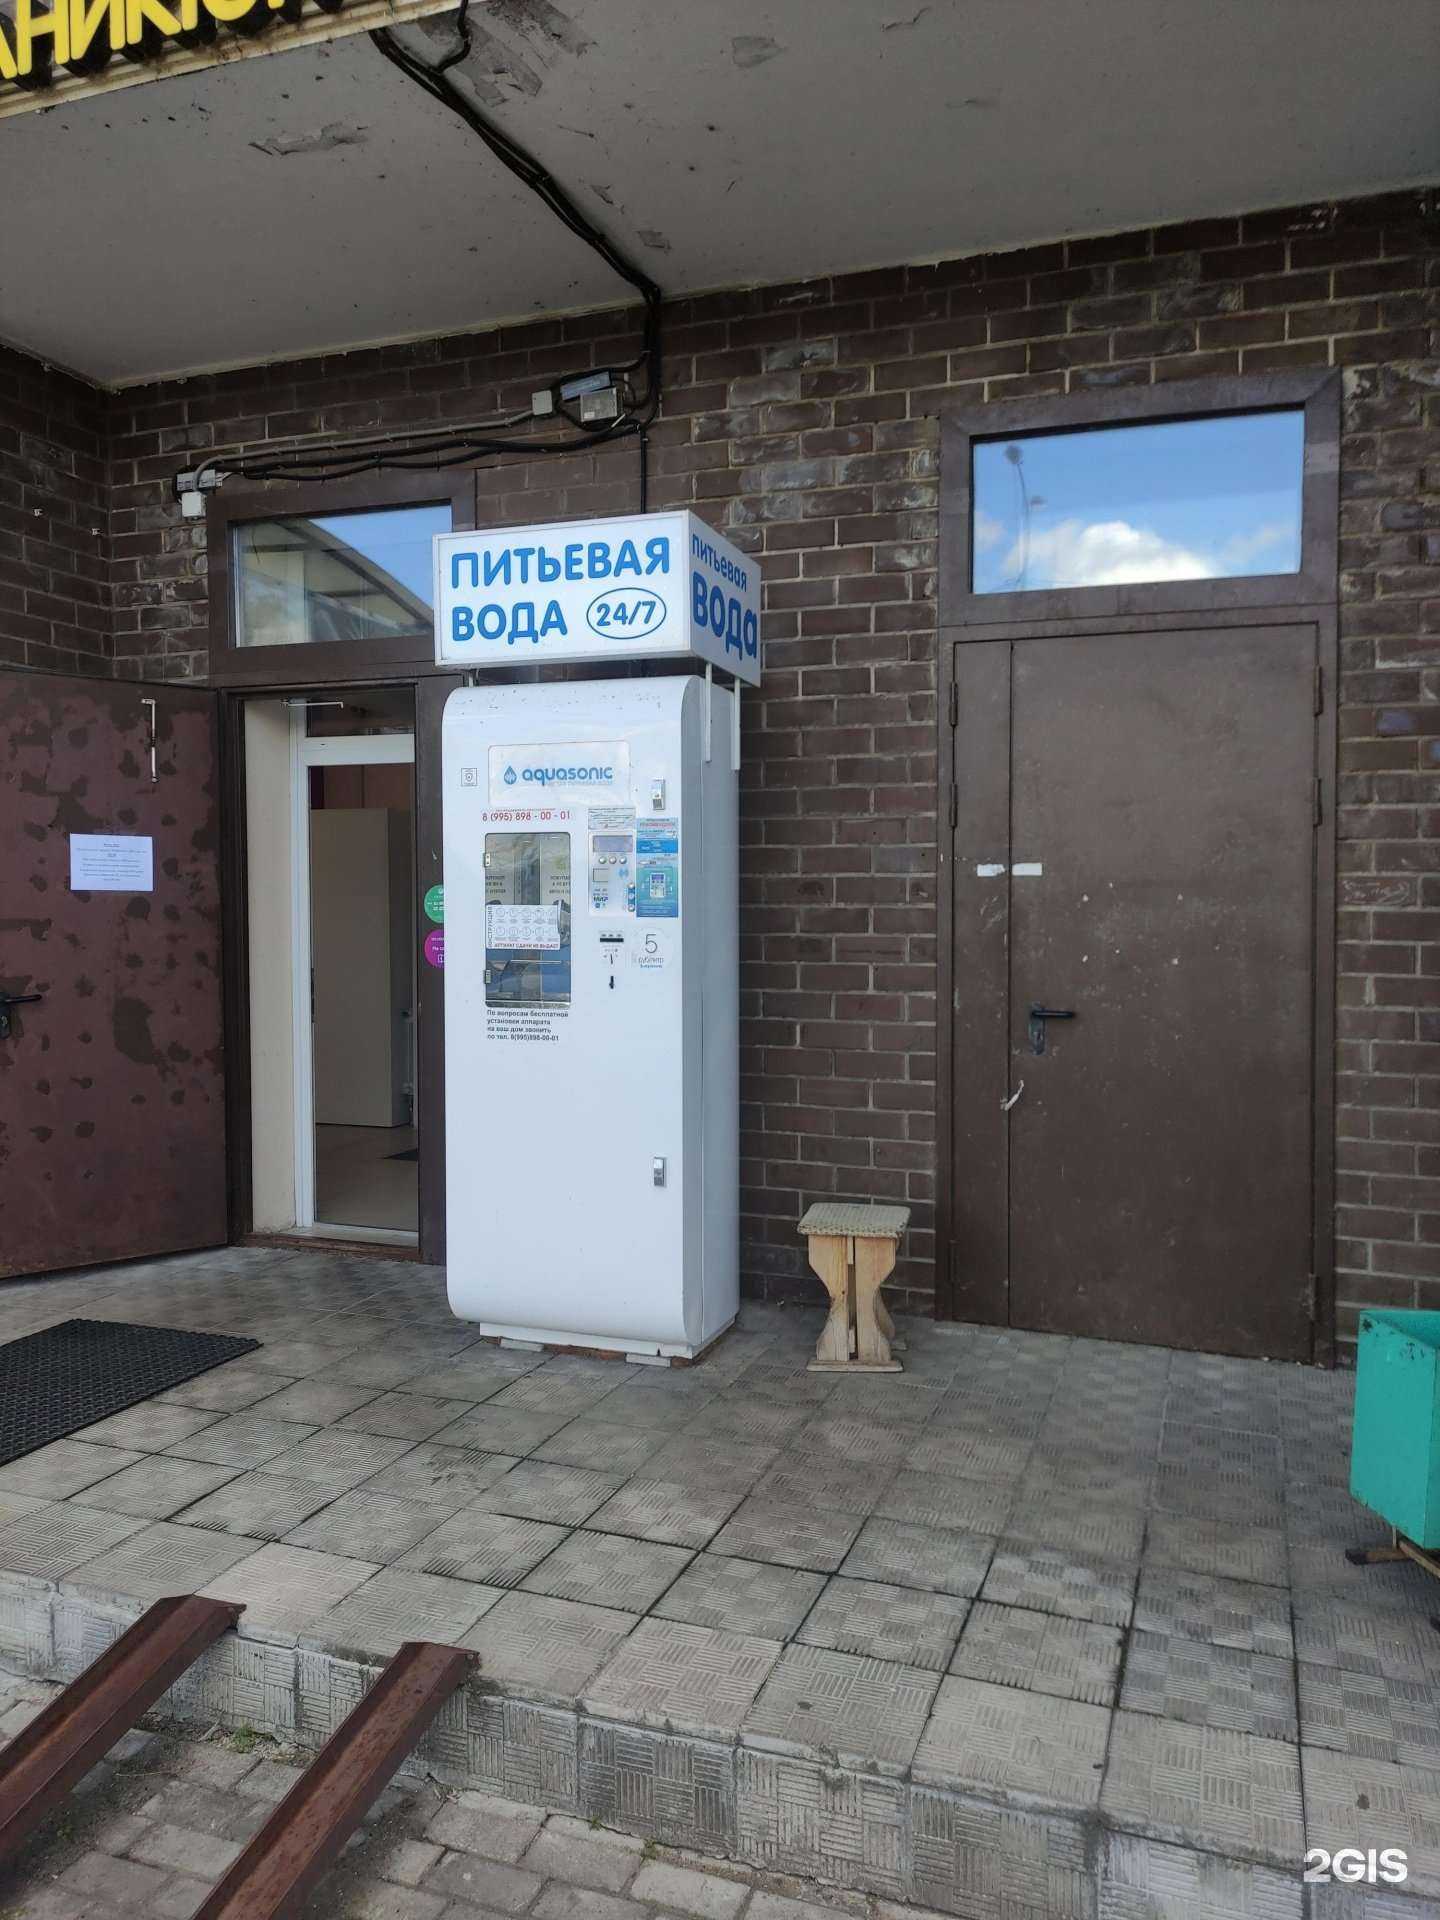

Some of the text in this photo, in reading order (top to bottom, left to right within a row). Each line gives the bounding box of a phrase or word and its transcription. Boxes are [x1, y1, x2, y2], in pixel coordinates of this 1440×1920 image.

[451, 537, 670, 589] ПИТЬЕВАЯ
[452, 599, 657, 645] ВОДА 24/7
[522, 766, 613, 787] aquasonic
[482, 812, 488, 821] 8
[490, 812, 513, 822] (995)
[515, 811, 531, 821] 898
[540, 811, 551, 820] 00
[560, 810, 570, 820] 01
[645, 933, 658, 953] 5
